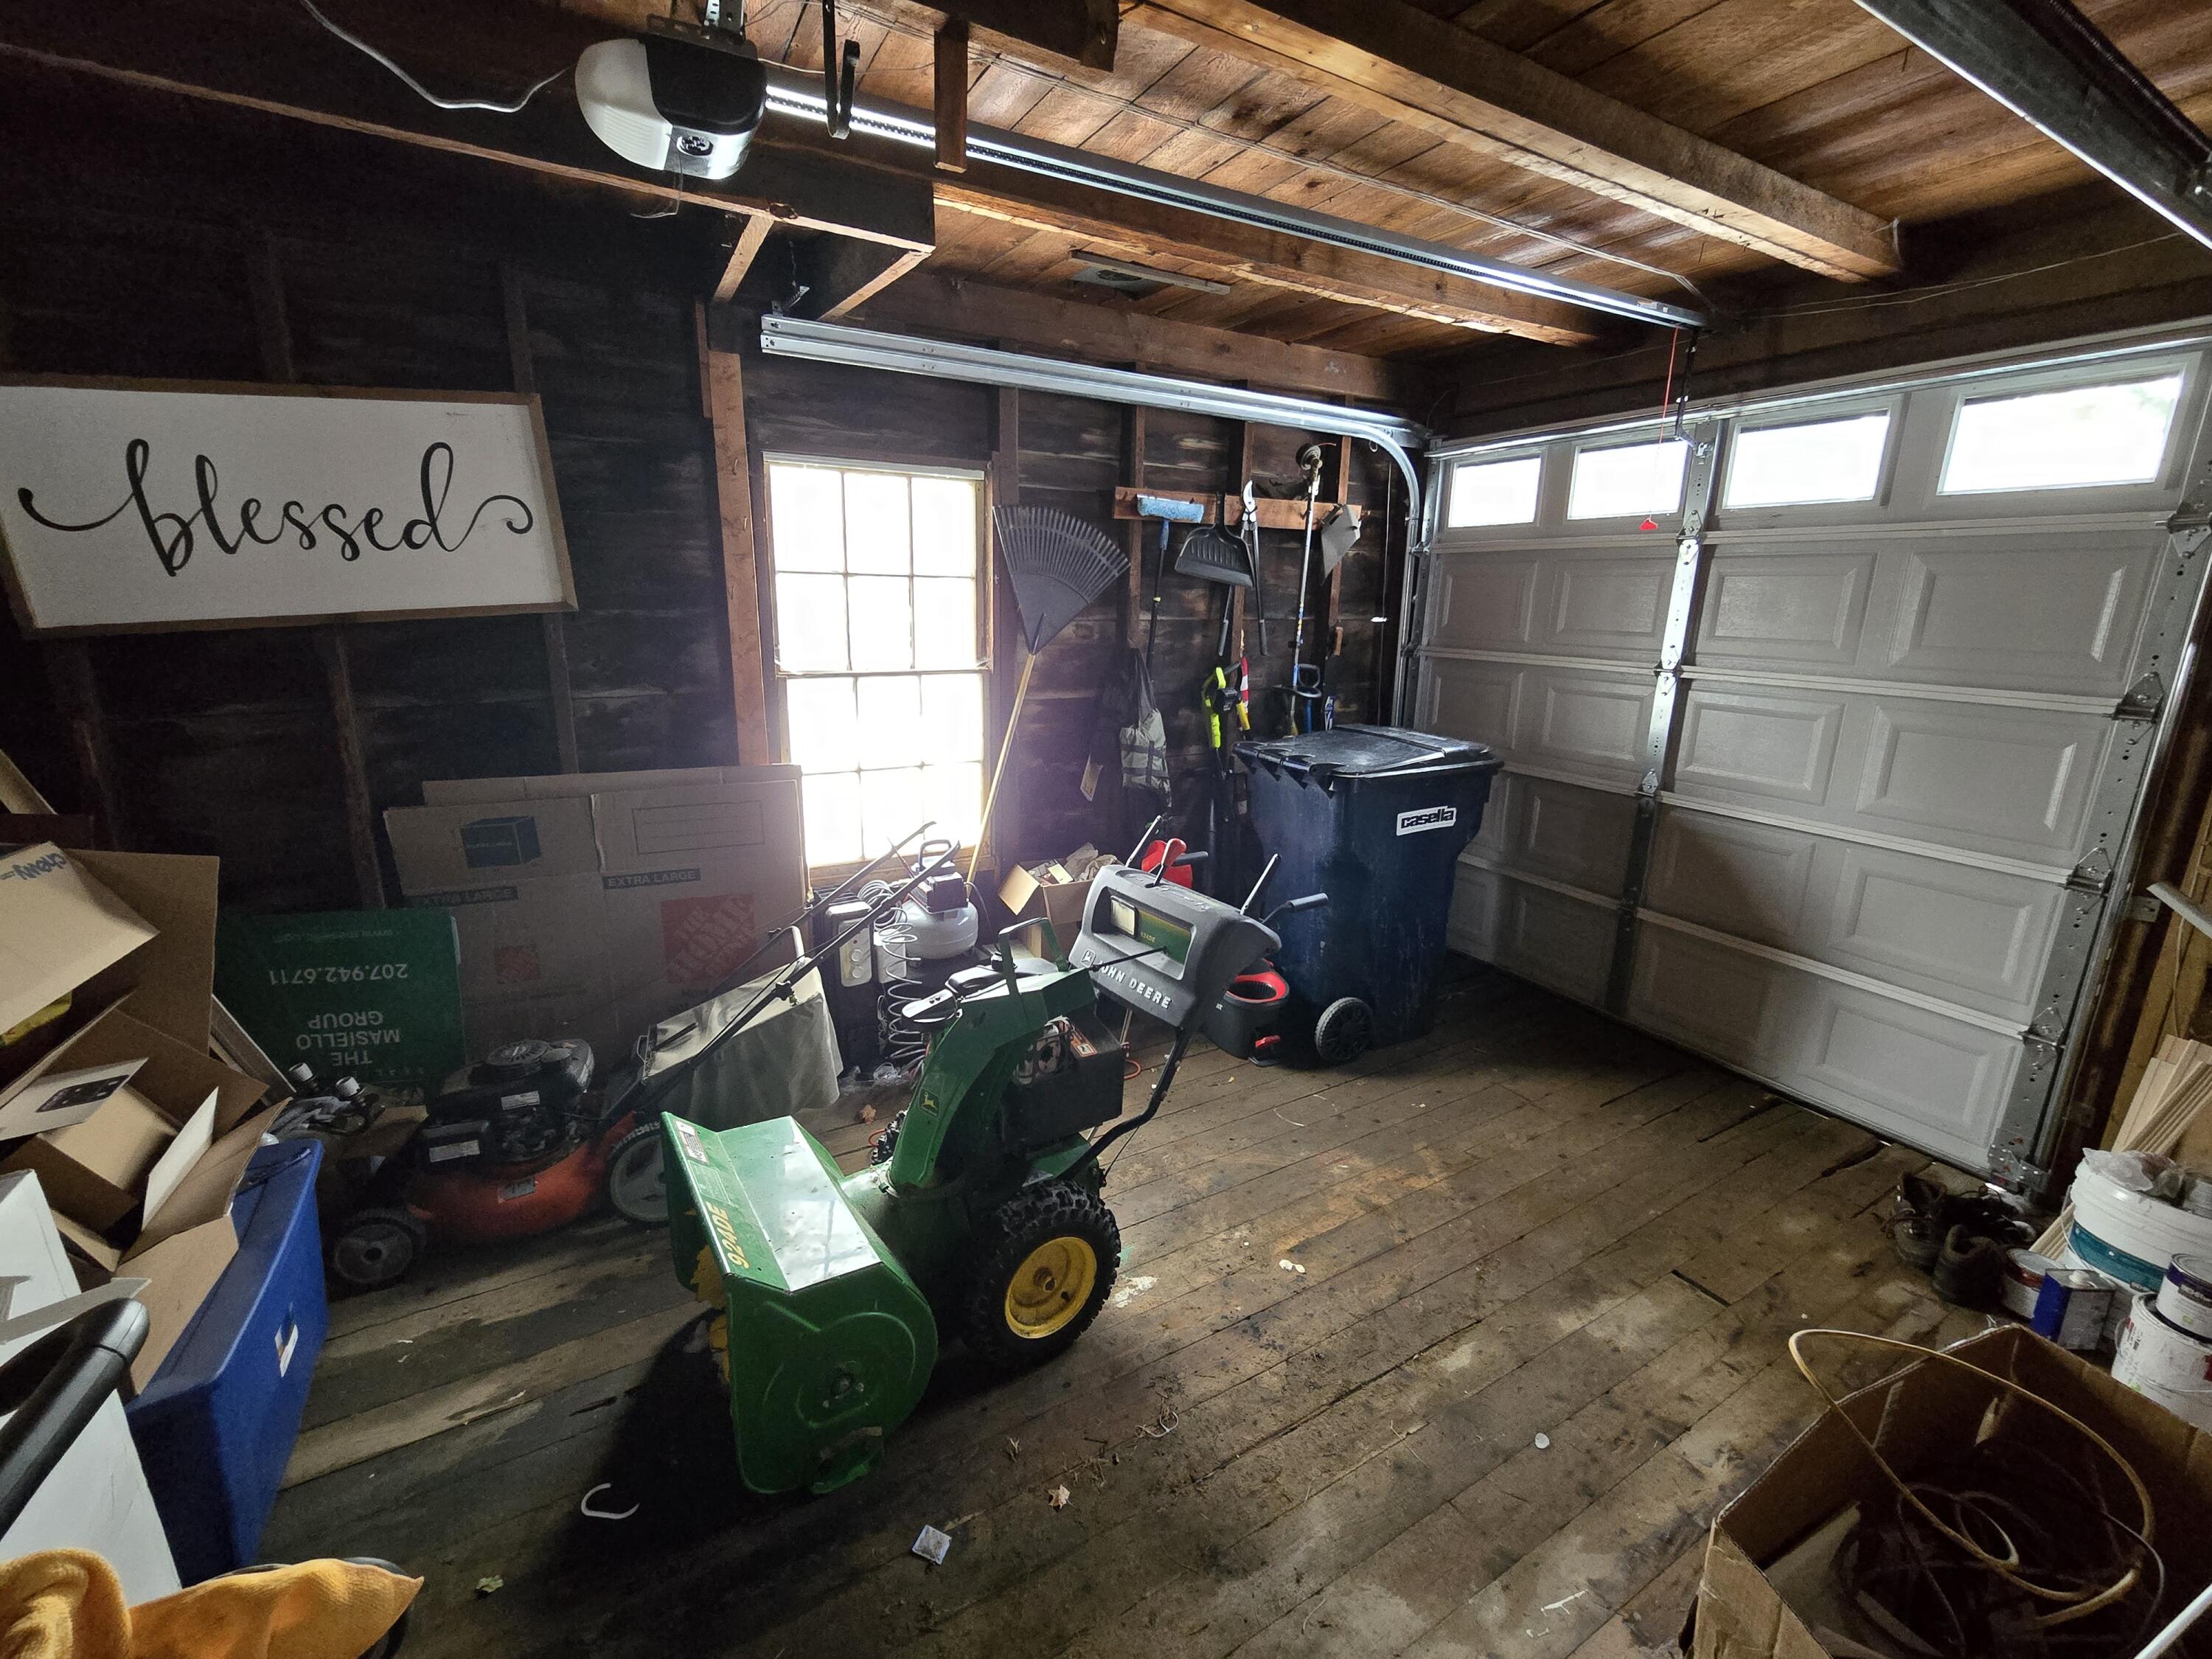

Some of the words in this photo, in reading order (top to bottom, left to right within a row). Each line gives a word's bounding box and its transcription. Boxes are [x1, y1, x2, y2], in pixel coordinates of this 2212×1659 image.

[18, 439, 533, 576] blessed
[1401, 808, 1454, 829] casella
[608, 874, 650, 887] EXTRA
[653, 870, 697, 883] LARGE
[268, 963, 408, 985] 207.942.6711
[1128, 977, 1171, 1009] DEERE
[307, 1010, 384, 1029] GROUP
[295, 1029, 402, 1051] MASIELLO
[330, 1050, 372, 1067] THE
[705, 1200, 750, 1269] 924DE
